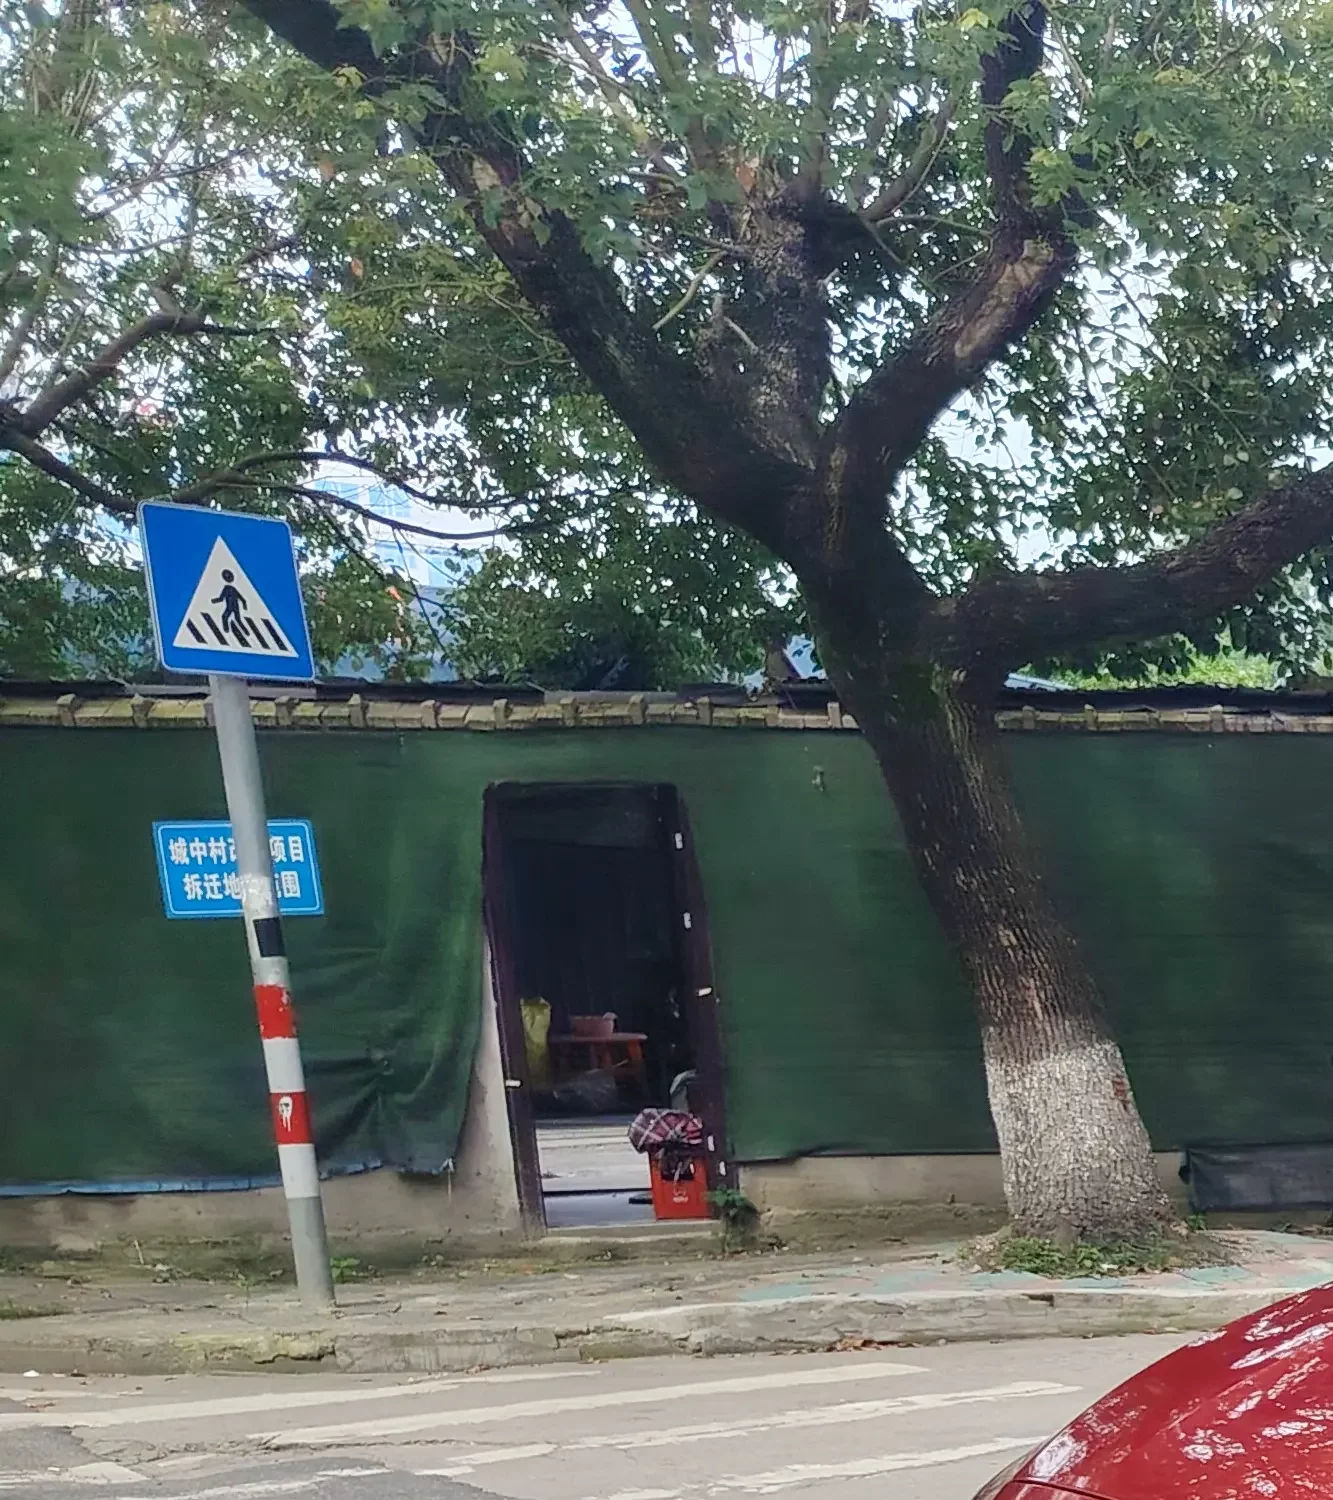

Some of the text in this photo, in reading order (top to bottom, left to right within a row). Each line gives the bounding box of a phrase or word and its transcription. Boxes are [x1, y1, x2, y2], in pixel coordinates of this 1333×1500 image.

[169, 836, 304, 864] 城中村项目
[183, 871, 301, 900] 拆迁地围
